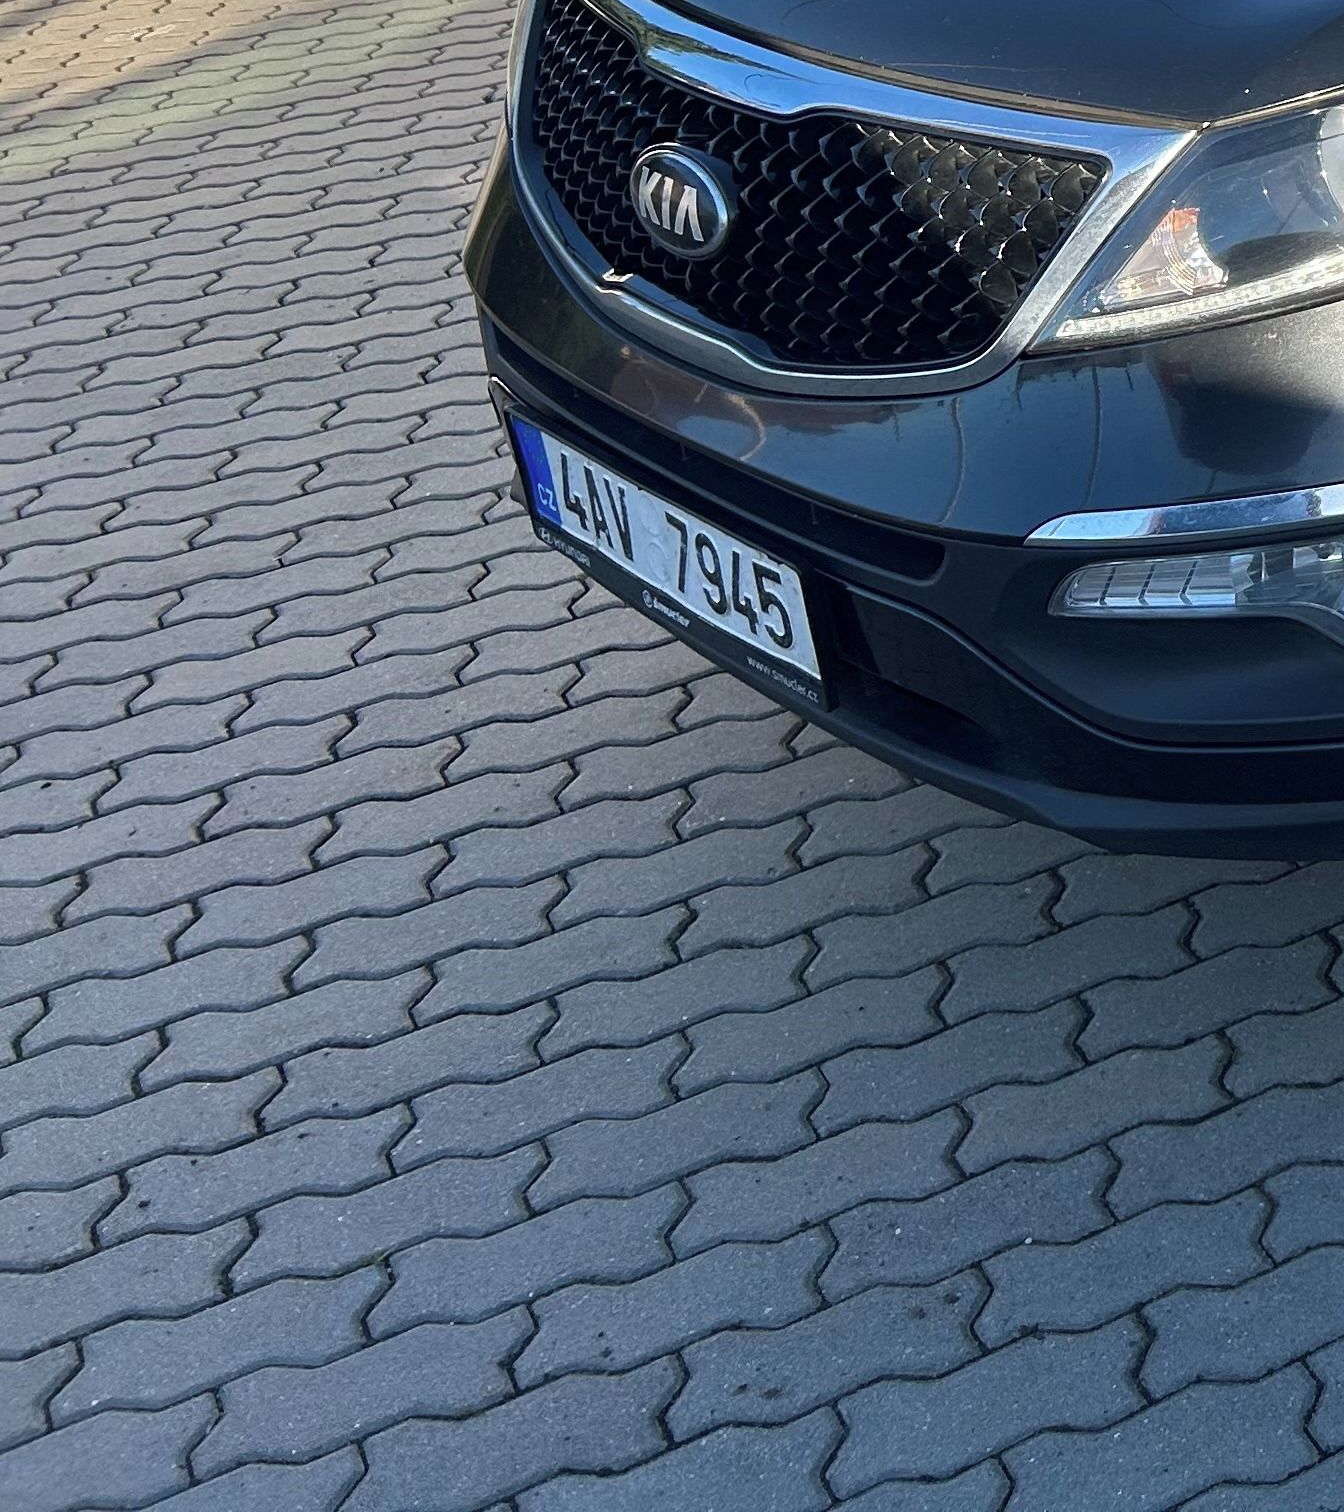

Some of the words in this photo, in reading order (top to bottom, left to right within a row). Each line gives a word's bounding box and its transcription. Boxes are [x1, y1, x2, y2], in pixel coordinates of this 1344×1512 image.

[638, 165, 705, 242] KIA
[537, 482, 557, 512] CZ
[560, 452, 634, 562] 4AV
[664, 510, 793, 649] 7945
